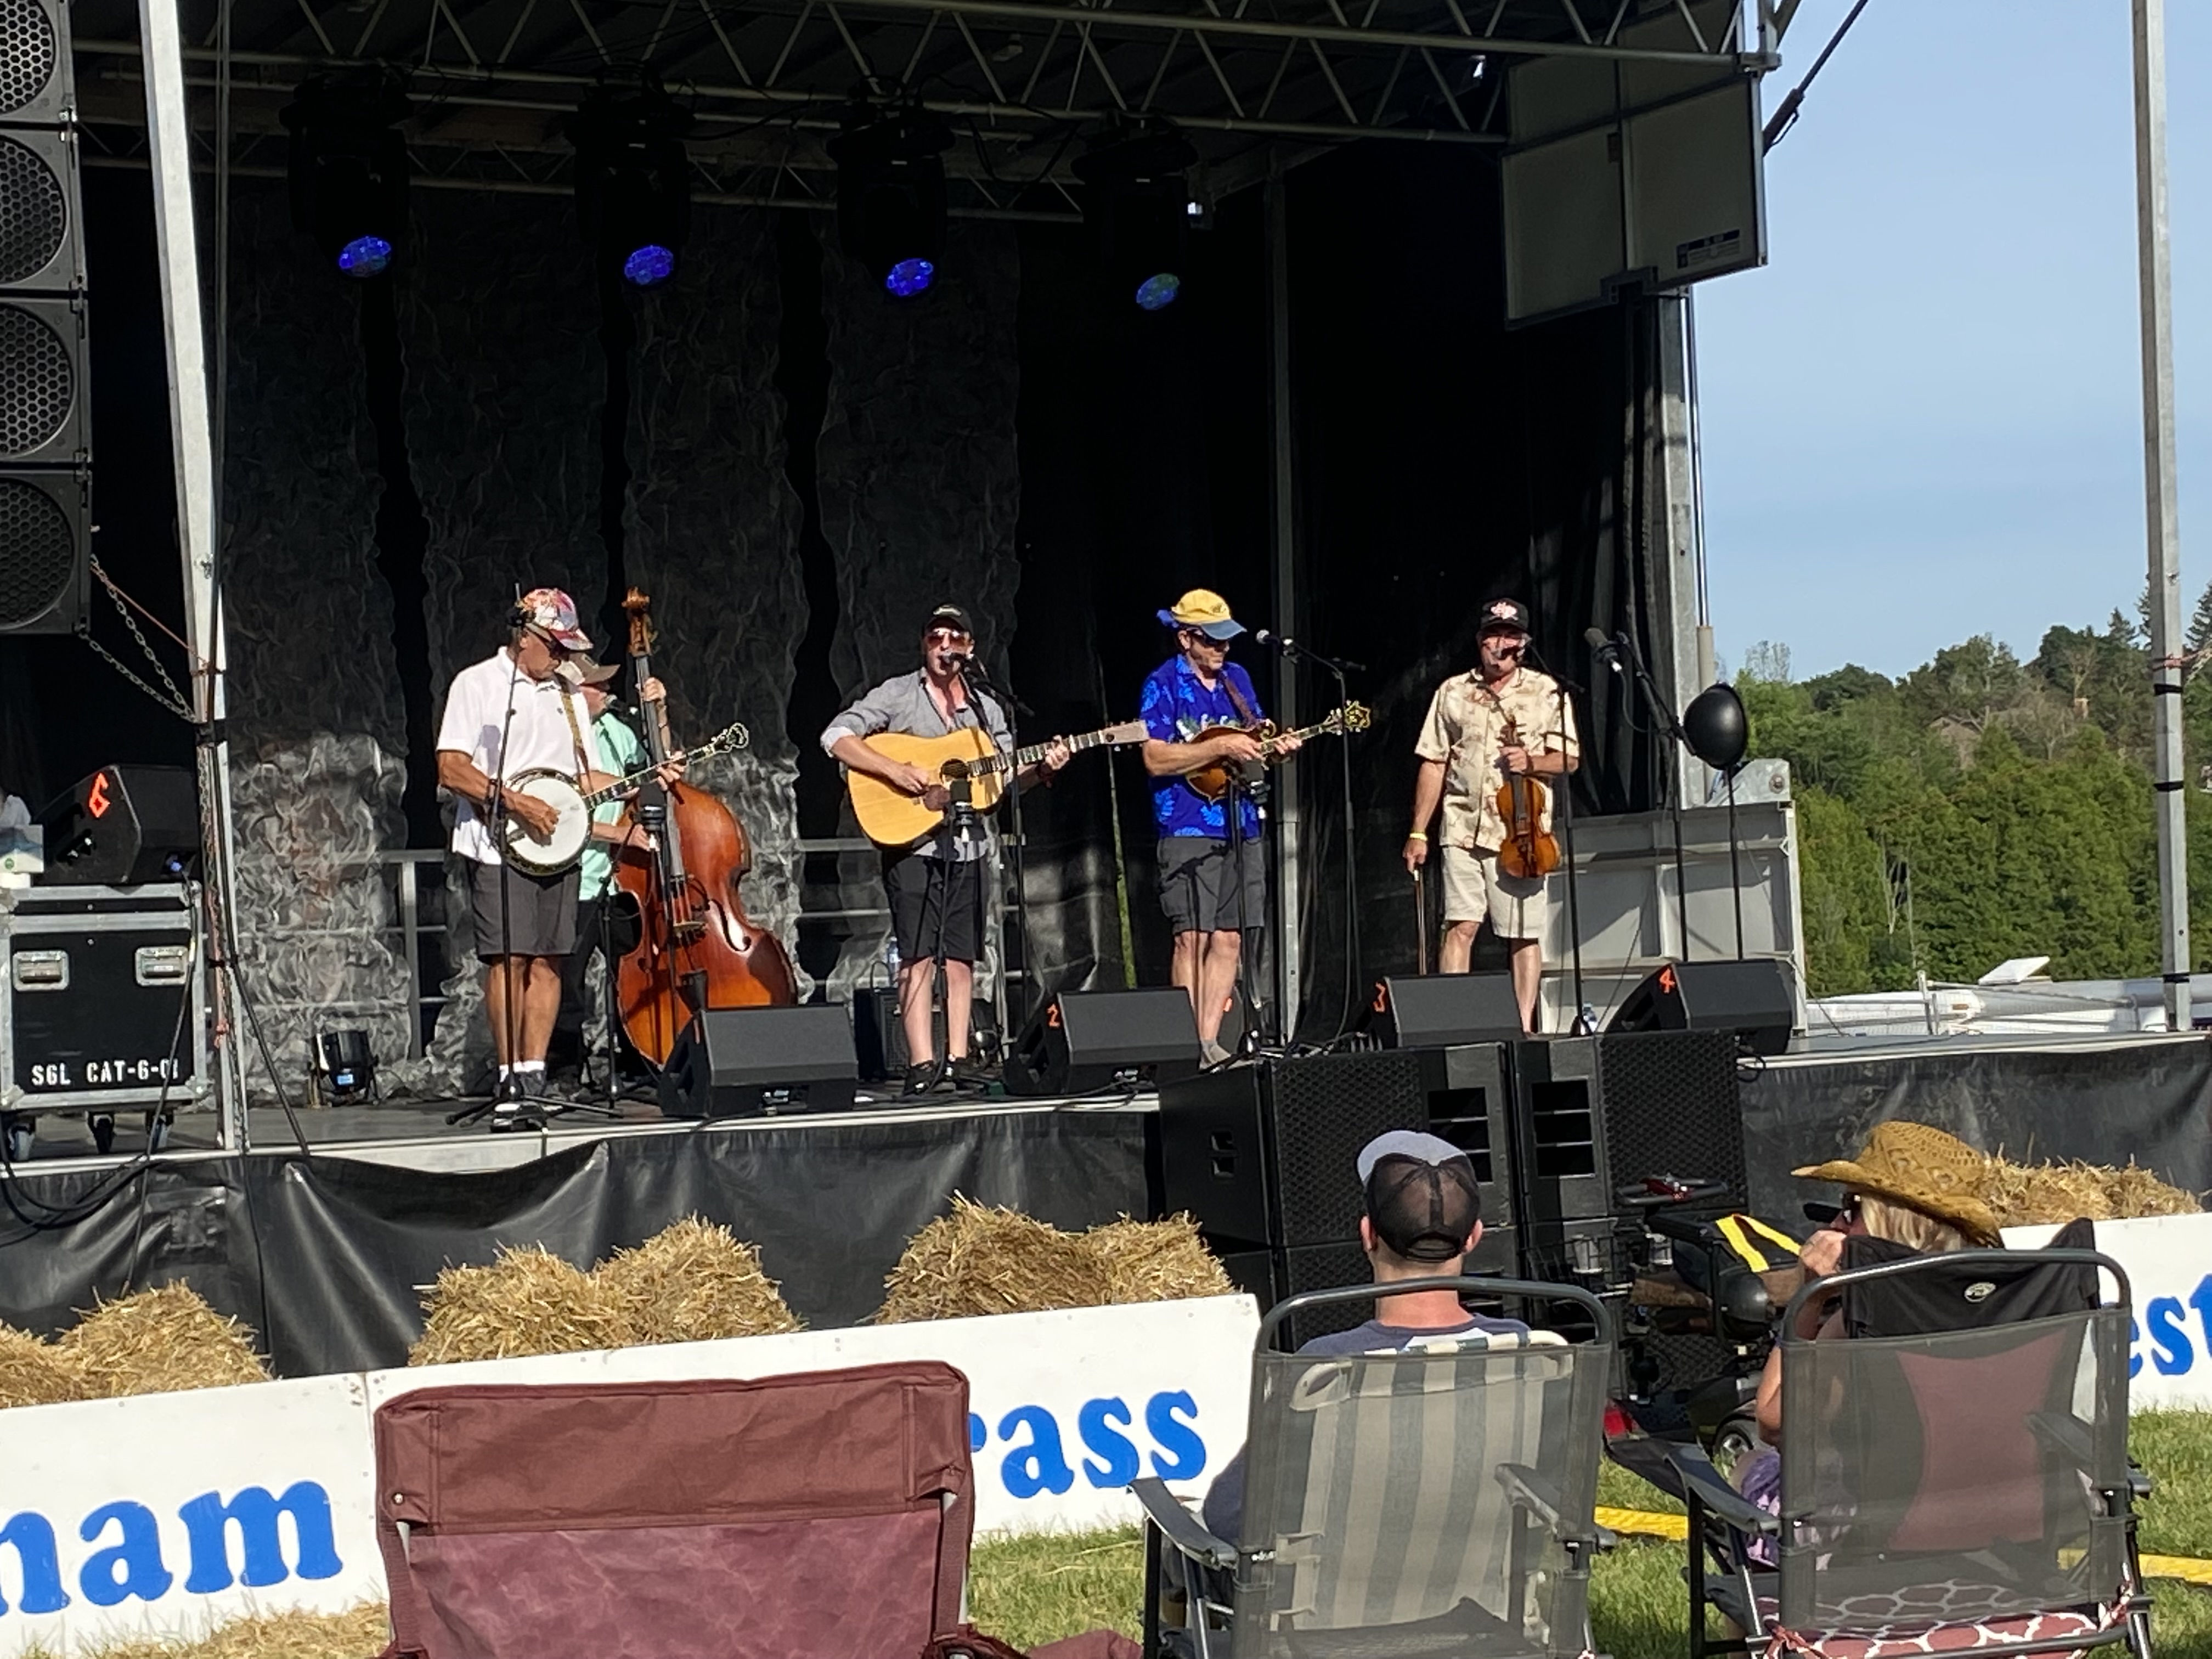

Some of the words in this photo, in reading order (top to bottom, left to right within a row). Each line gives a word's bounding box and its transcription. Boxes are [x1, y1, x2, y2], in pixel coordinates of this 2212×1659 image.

[88, 772, 111, 818] 6
[1658, 968, 1675, 994] 4
[1046, 1003, 1060, 1028] 2
[969, 1390, 1207, 1499] ass
